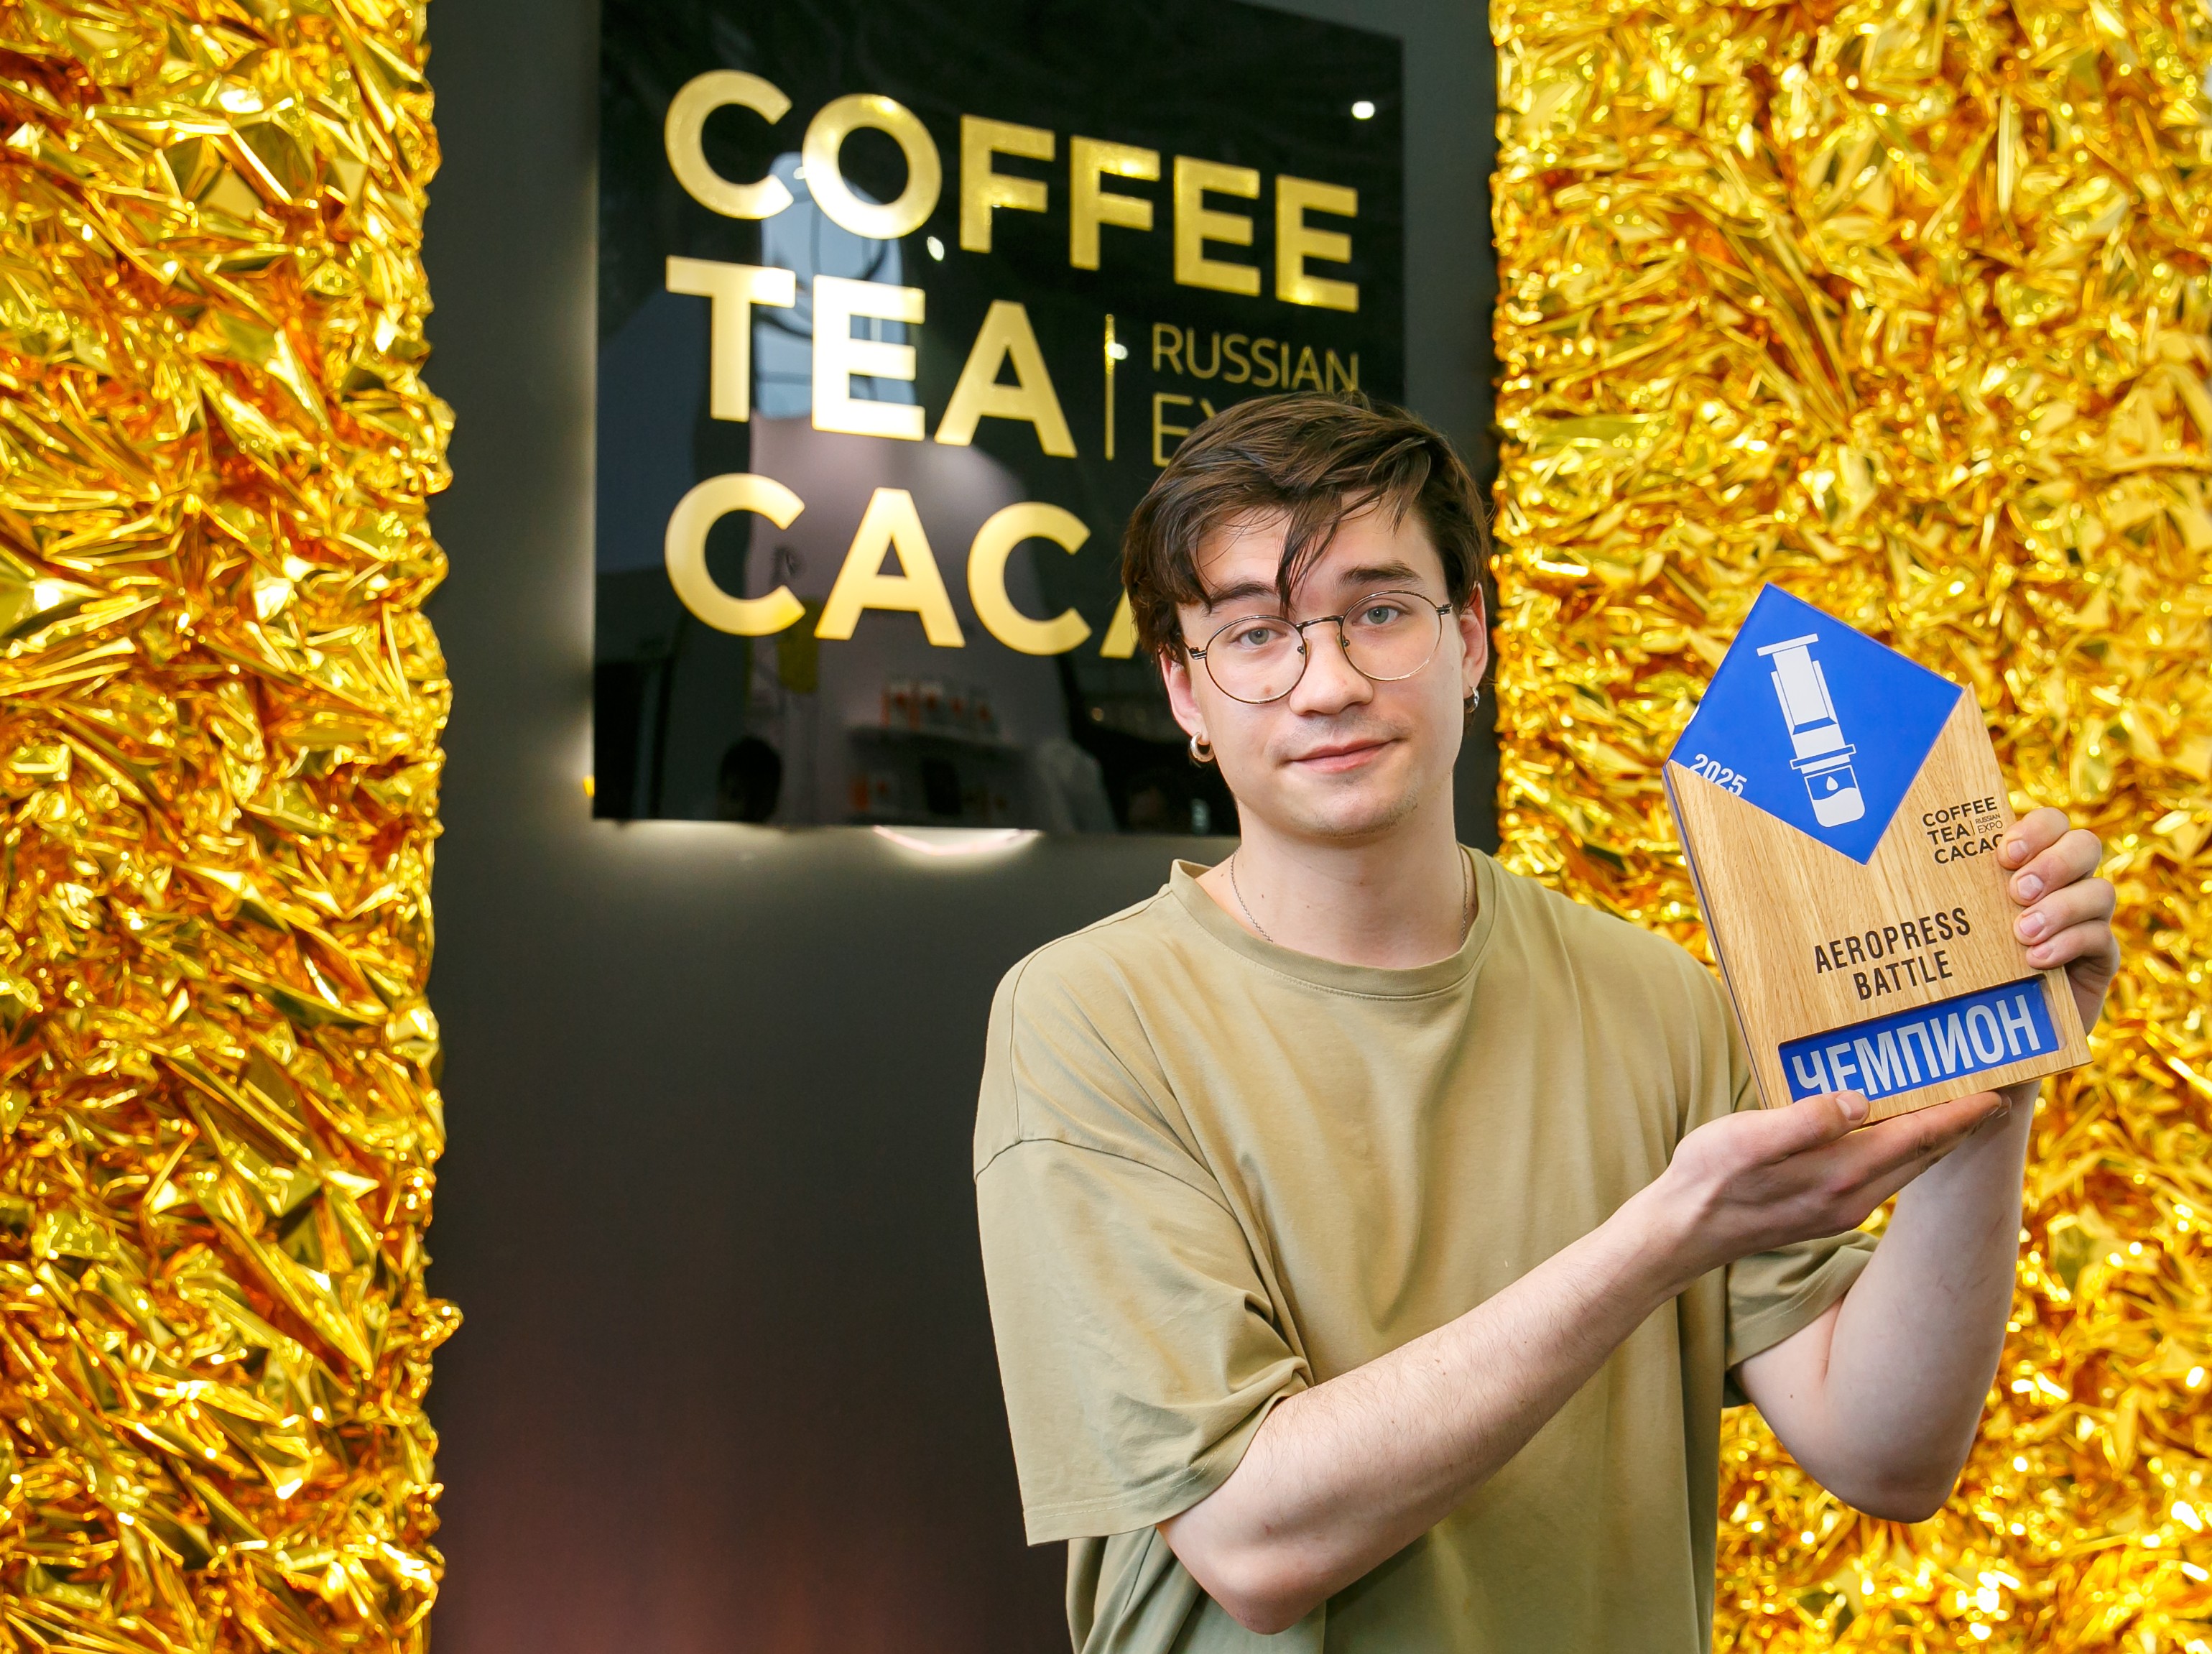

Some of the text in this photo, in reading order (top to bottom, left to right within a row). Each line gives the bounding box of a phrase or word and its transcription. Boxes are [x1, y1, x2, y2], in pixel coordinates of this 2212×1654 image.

[665, 69, 1359, 313] COFFEE
[665, 256, 1078, 458] TEA
[1152, 322, 1359, 393] RUSSIAN
[1689, 753, 1747, 796] 2025
[1922, 797, 1997, 827] COFFEE
[1927, 823, 1971, 845] TEA
[1975, 813, 2001, 824] RUSSIAN
[1977, 820, 2003, 833] EXPO
[1814, 907, 1971, 974] AEROPRESS
[1853, 950, 1953, 1001] BATTLE
[1792, 994, 2041, 1096] ЧЕМПИОН
